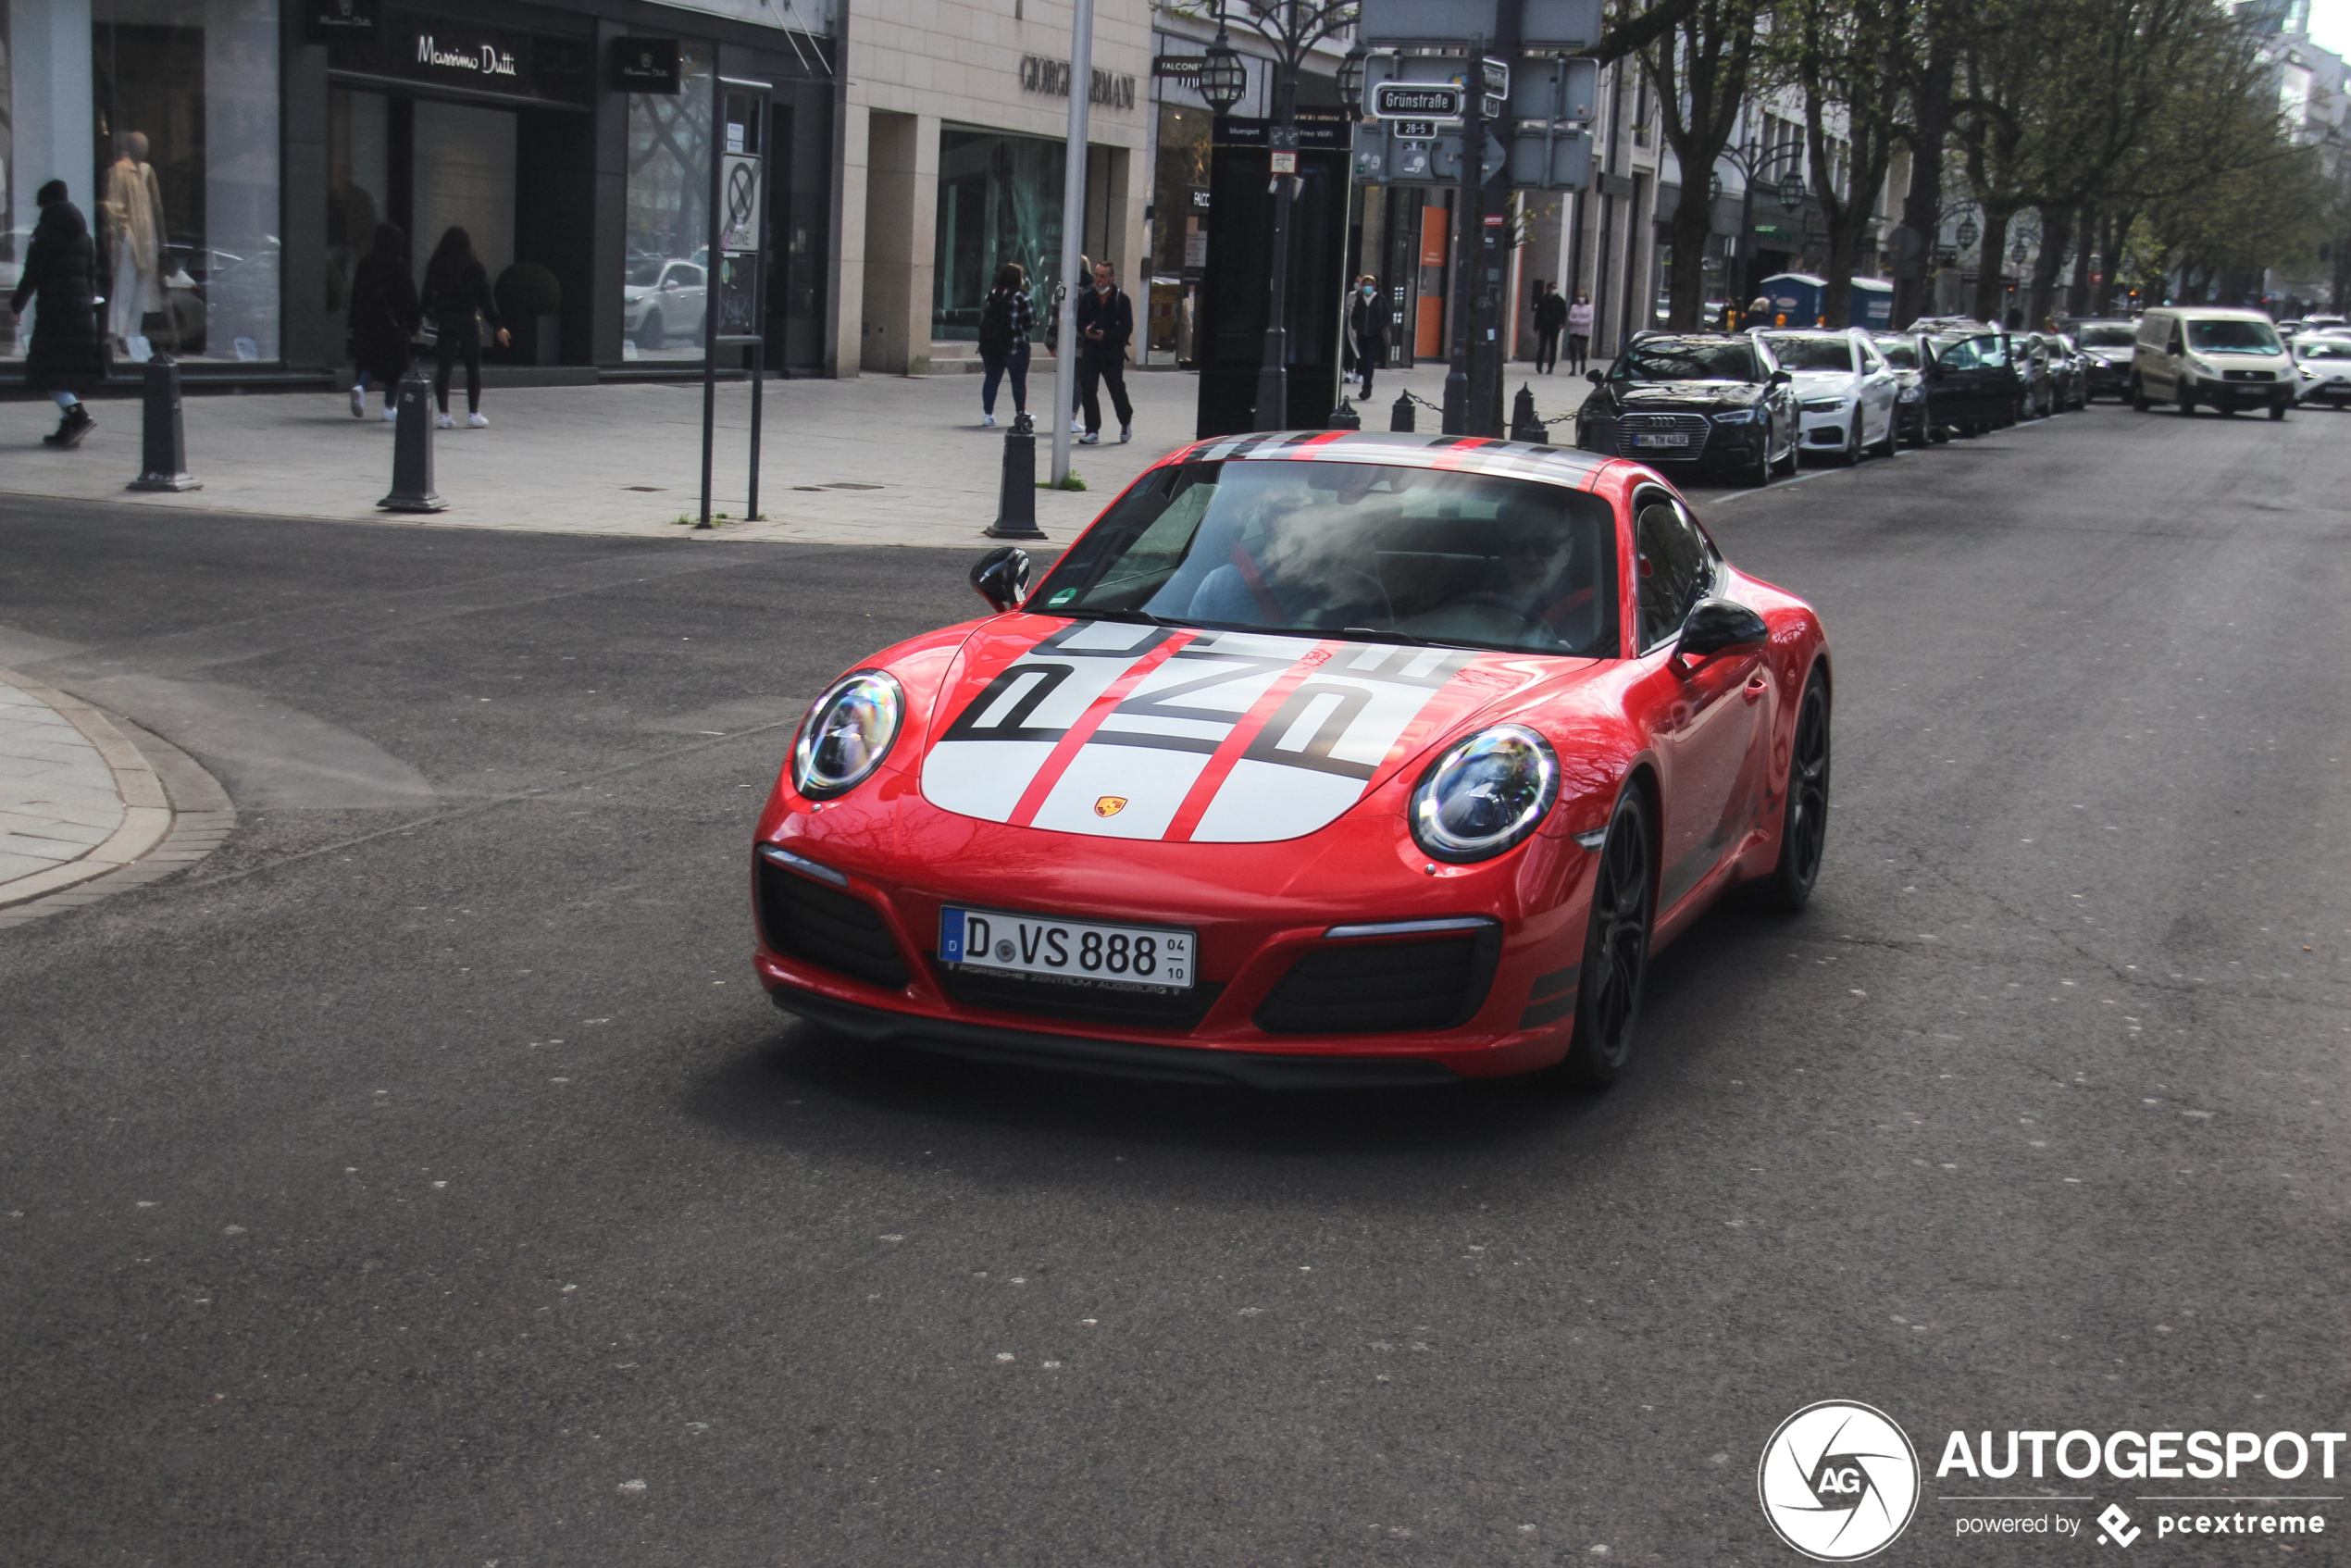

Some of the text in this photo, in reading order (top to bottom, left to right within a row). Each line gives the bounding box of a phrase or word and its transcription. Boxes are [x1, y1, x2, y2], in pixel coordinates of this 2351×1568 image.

[418, 35, 516, 76] Massimo Dutti
[1162, 62, 1202, 71] FALCONE
[1019, 55, 1071, 97] GIORGI
[1088, 69, 1136, 110] RMANI
[1386, 93, 1449, 108] Grünstraße
[1229, 127, 1260, 136] bluespot
[1300, 130, 1315, 138] Free
[1317, 130, 1333, 138] WiFi
[1405, 123, 1426, 134] 26-5
[728, 230, 750, 246] ZONE
[1655, 435, 1665, 445] TH
[948, 940, 957, 952] D
[965, 916, 1157, 976] D VS 888
[1167, 939, 1186, 952] 04
[1167, 967, 1184, 979] 10
[959, 964, 1167, 995] PORSCHE ZENTRUM AUGSBURG
